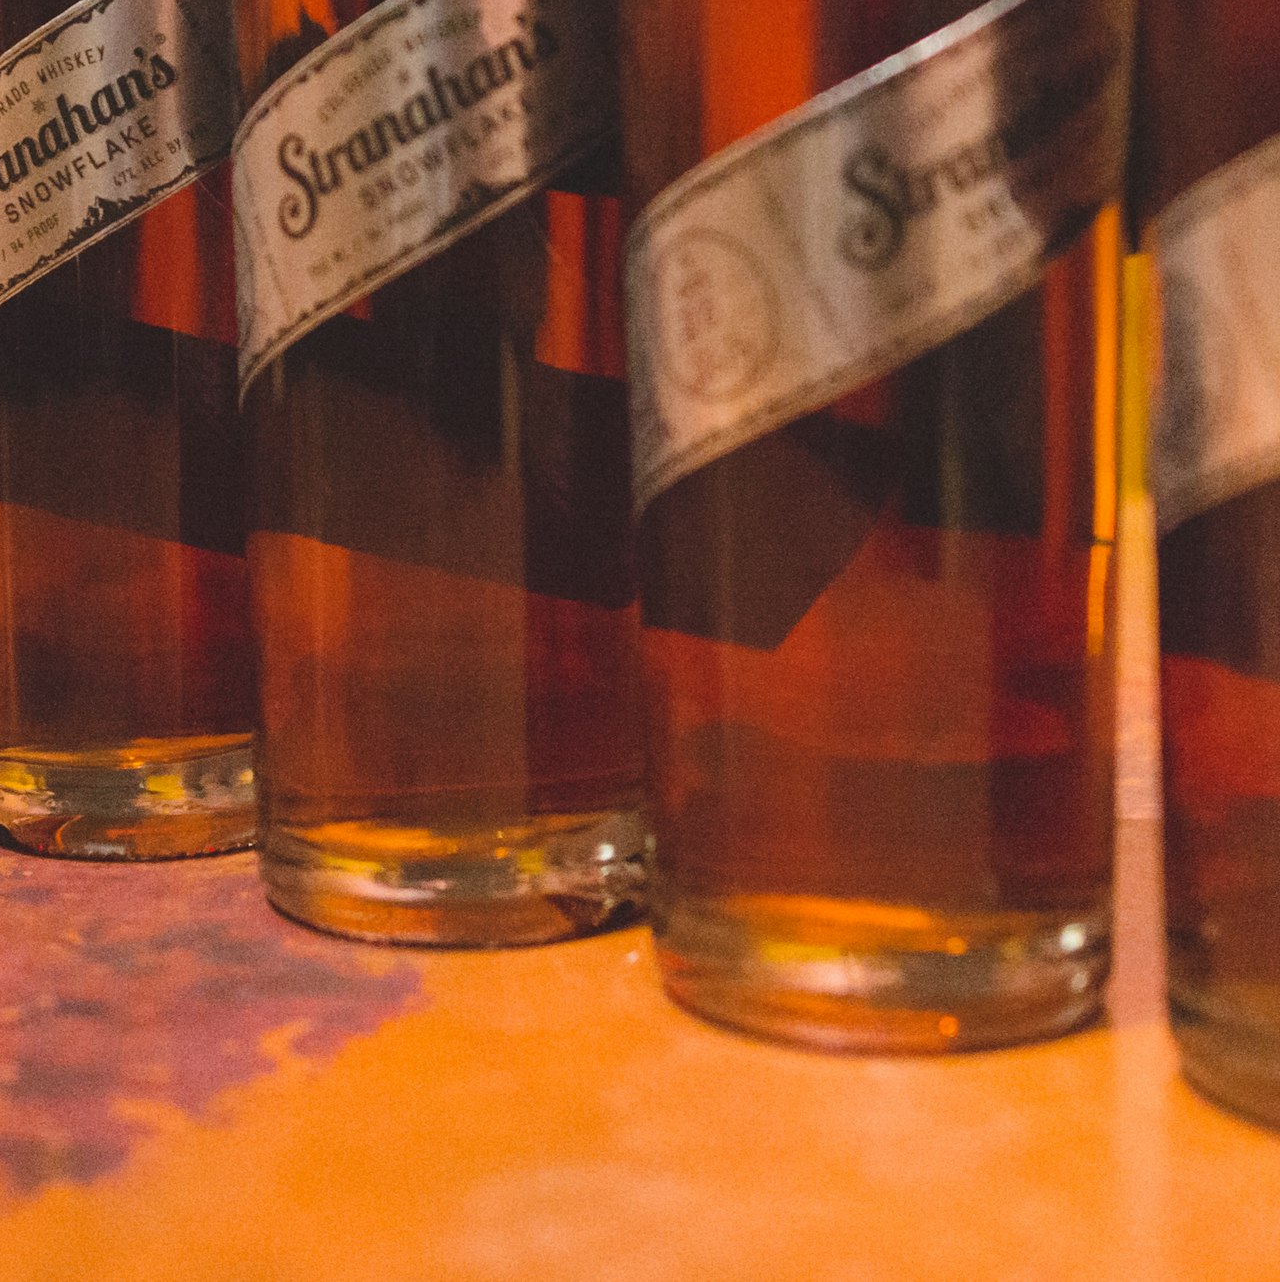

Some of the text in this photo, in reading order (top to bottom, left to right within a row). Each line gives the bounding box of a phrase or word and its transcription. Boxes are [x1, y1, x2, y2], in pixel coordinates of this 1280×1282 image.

[36, 44, 105, 85] WHISKEY
[3, 114, 157, 225] SNOWFLAKE
[141, 150, 165, 175] ALC
[168, 136, 183, 155] BY
[26, 212, 61, 242] PROOF
